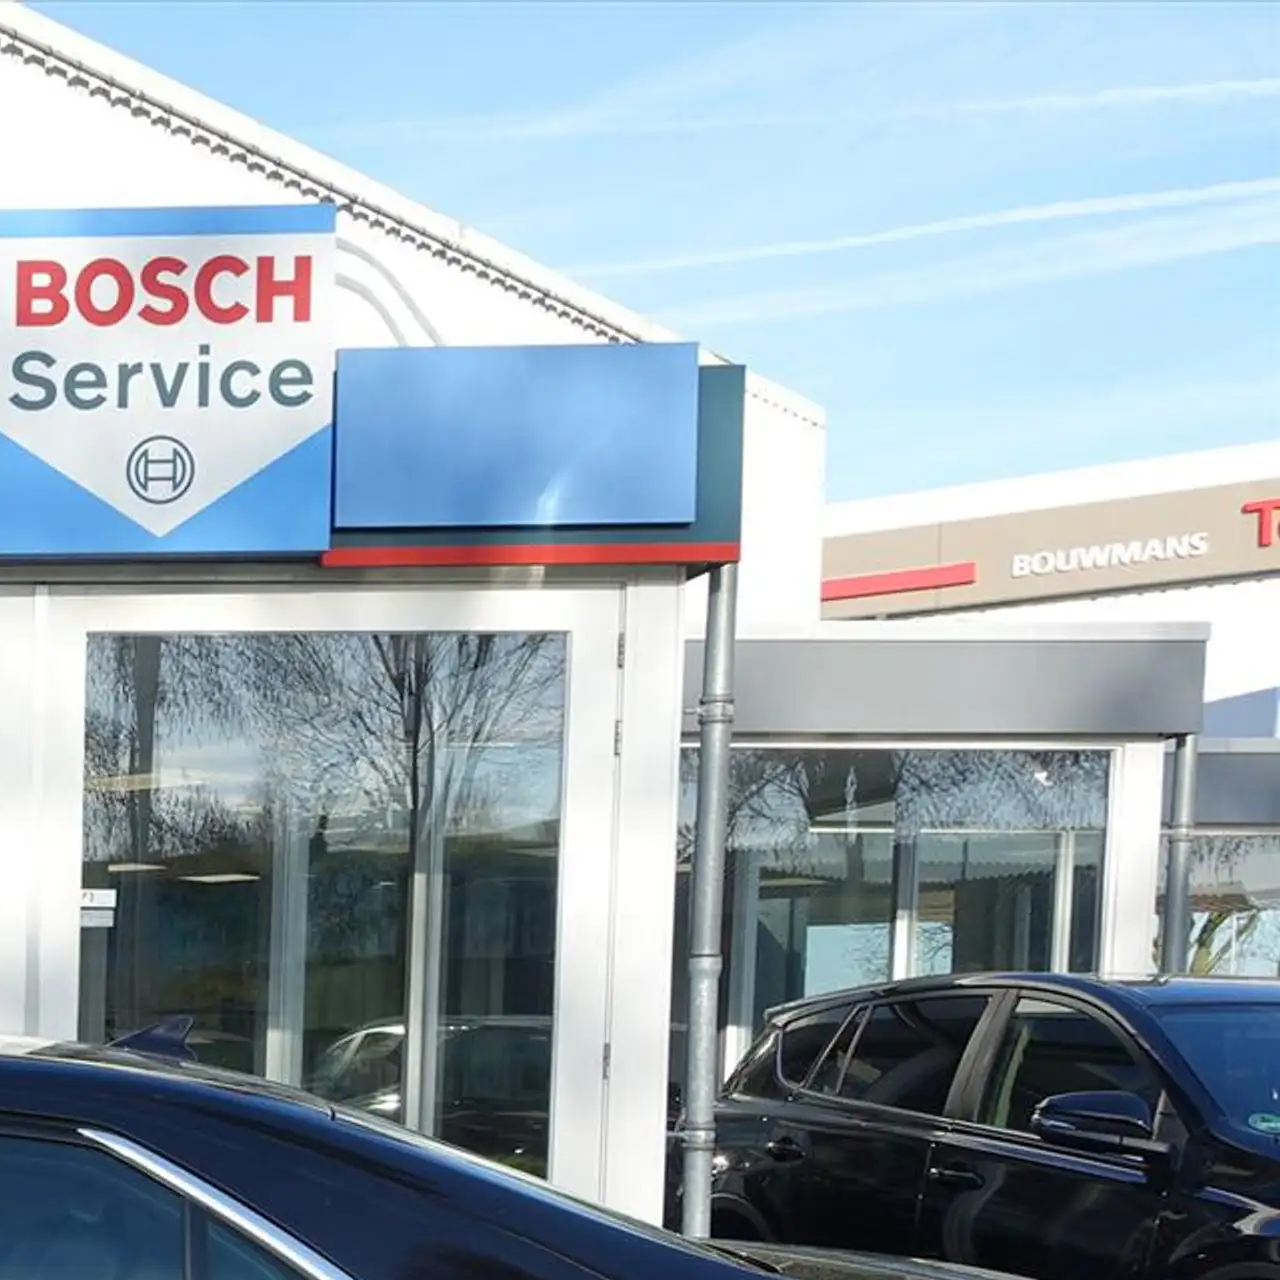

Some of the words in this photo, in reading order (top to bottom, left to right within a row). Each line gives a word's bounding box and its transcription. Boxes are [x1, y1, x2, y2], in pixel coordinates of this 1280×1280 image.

[15, 254, 312, 327] BOSCH
[9, 344, 314, 411] Service
[1010, 532, 1209, 579] BOUWMANS
